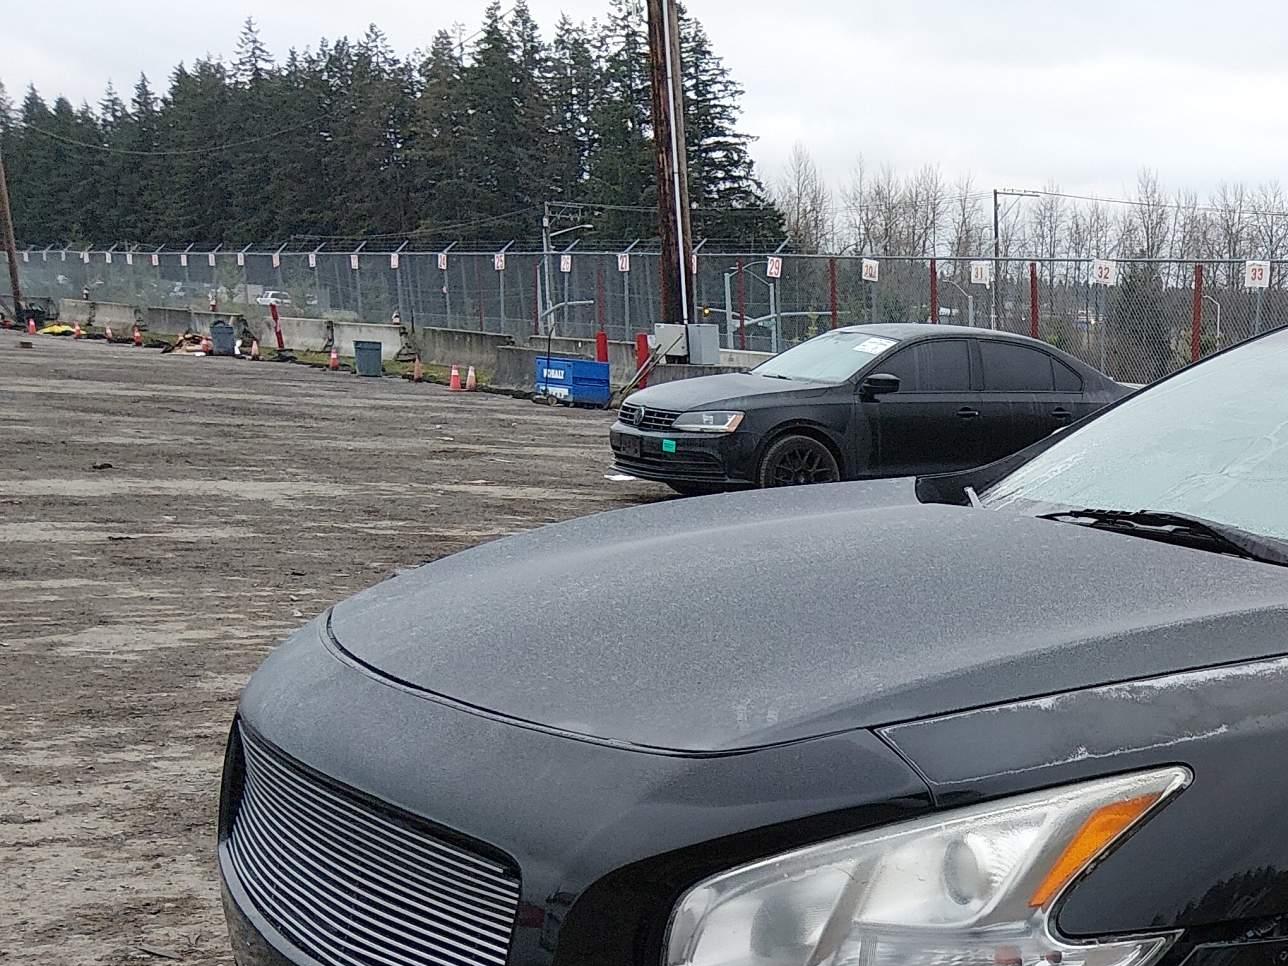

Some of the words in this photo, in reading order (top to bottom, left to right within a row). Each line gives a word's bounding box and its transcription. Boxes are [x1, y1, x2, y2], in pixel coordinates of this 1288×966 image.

[496, 255, 504, 269] 25
[768, 258, 780, 276] 29
[974, 267, 984, 279] 31
[1097, 266, 1110, 280] 32
[1250, 268, 1264, 281] 33
